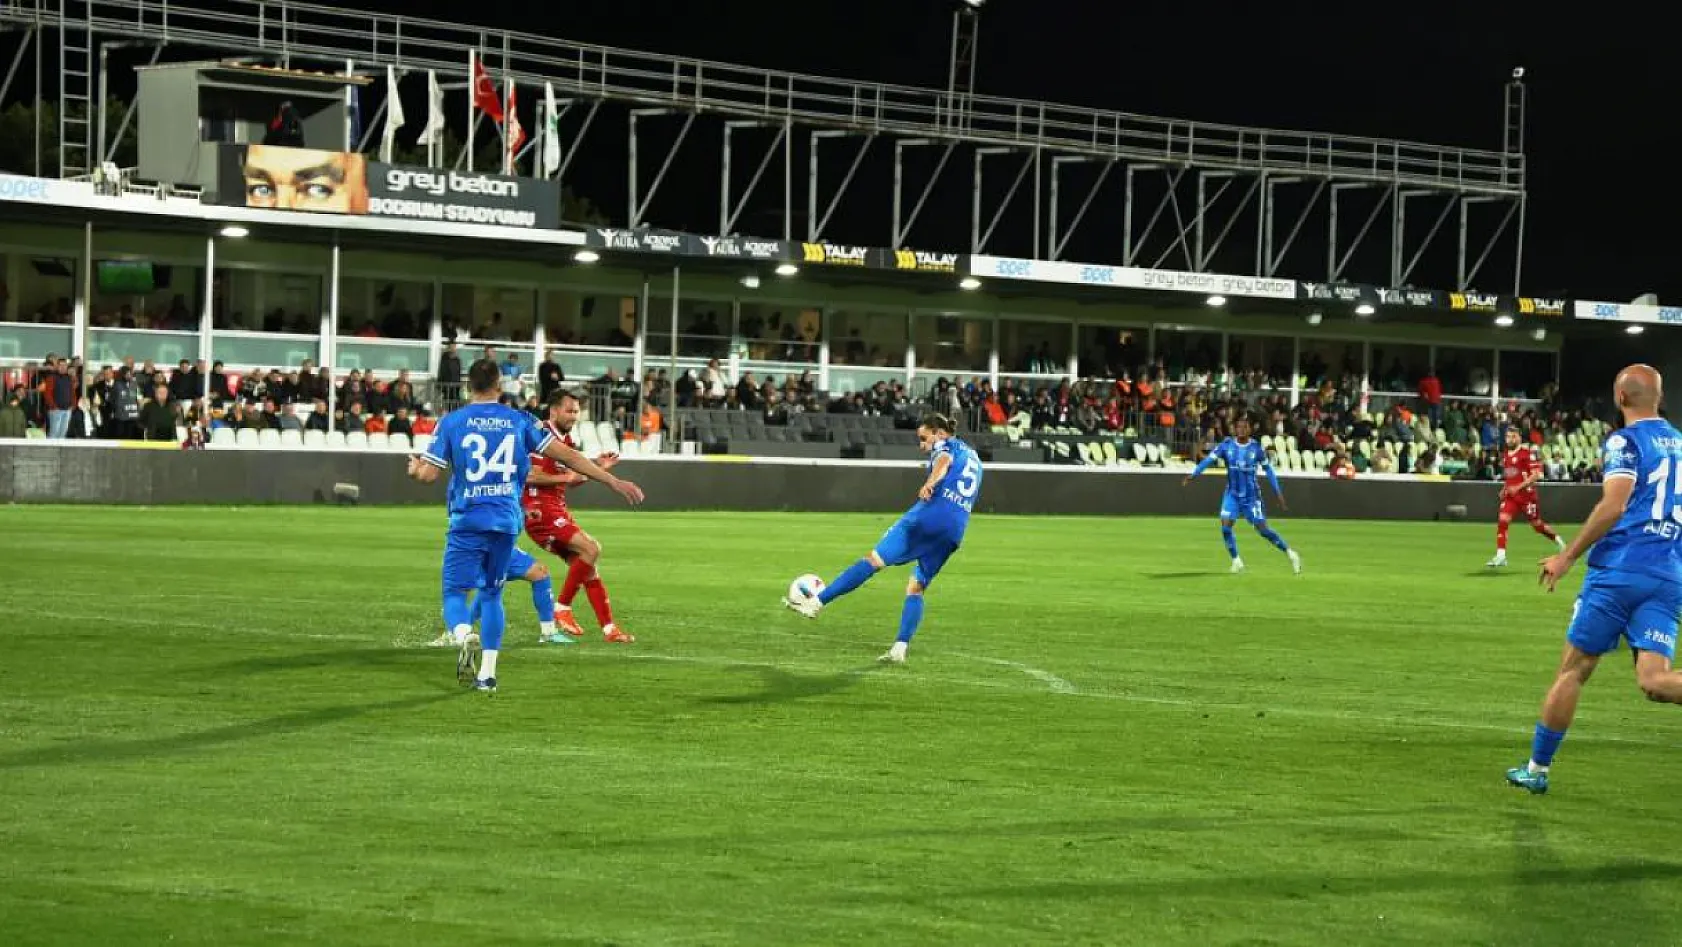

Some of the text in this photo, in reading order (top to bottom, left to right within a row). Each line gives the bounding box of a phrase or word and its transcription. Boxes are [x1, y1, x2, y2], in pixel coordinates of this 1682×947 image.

[387, 169, 518, 197] grey beton
[368, 198, 535, 226] BODRUM STADYUMU
[824, 243, 866, 260] TALAY
[916, 251, 957, 266] TALAY
[1467, 294, 1497, 306] TALAY
[1534, 299, 1565, 312] TALAY
[461, 433, 518, 483] 34
[957, 452, 979, 498] 5
[1647, 456, 1682, 524] 15
